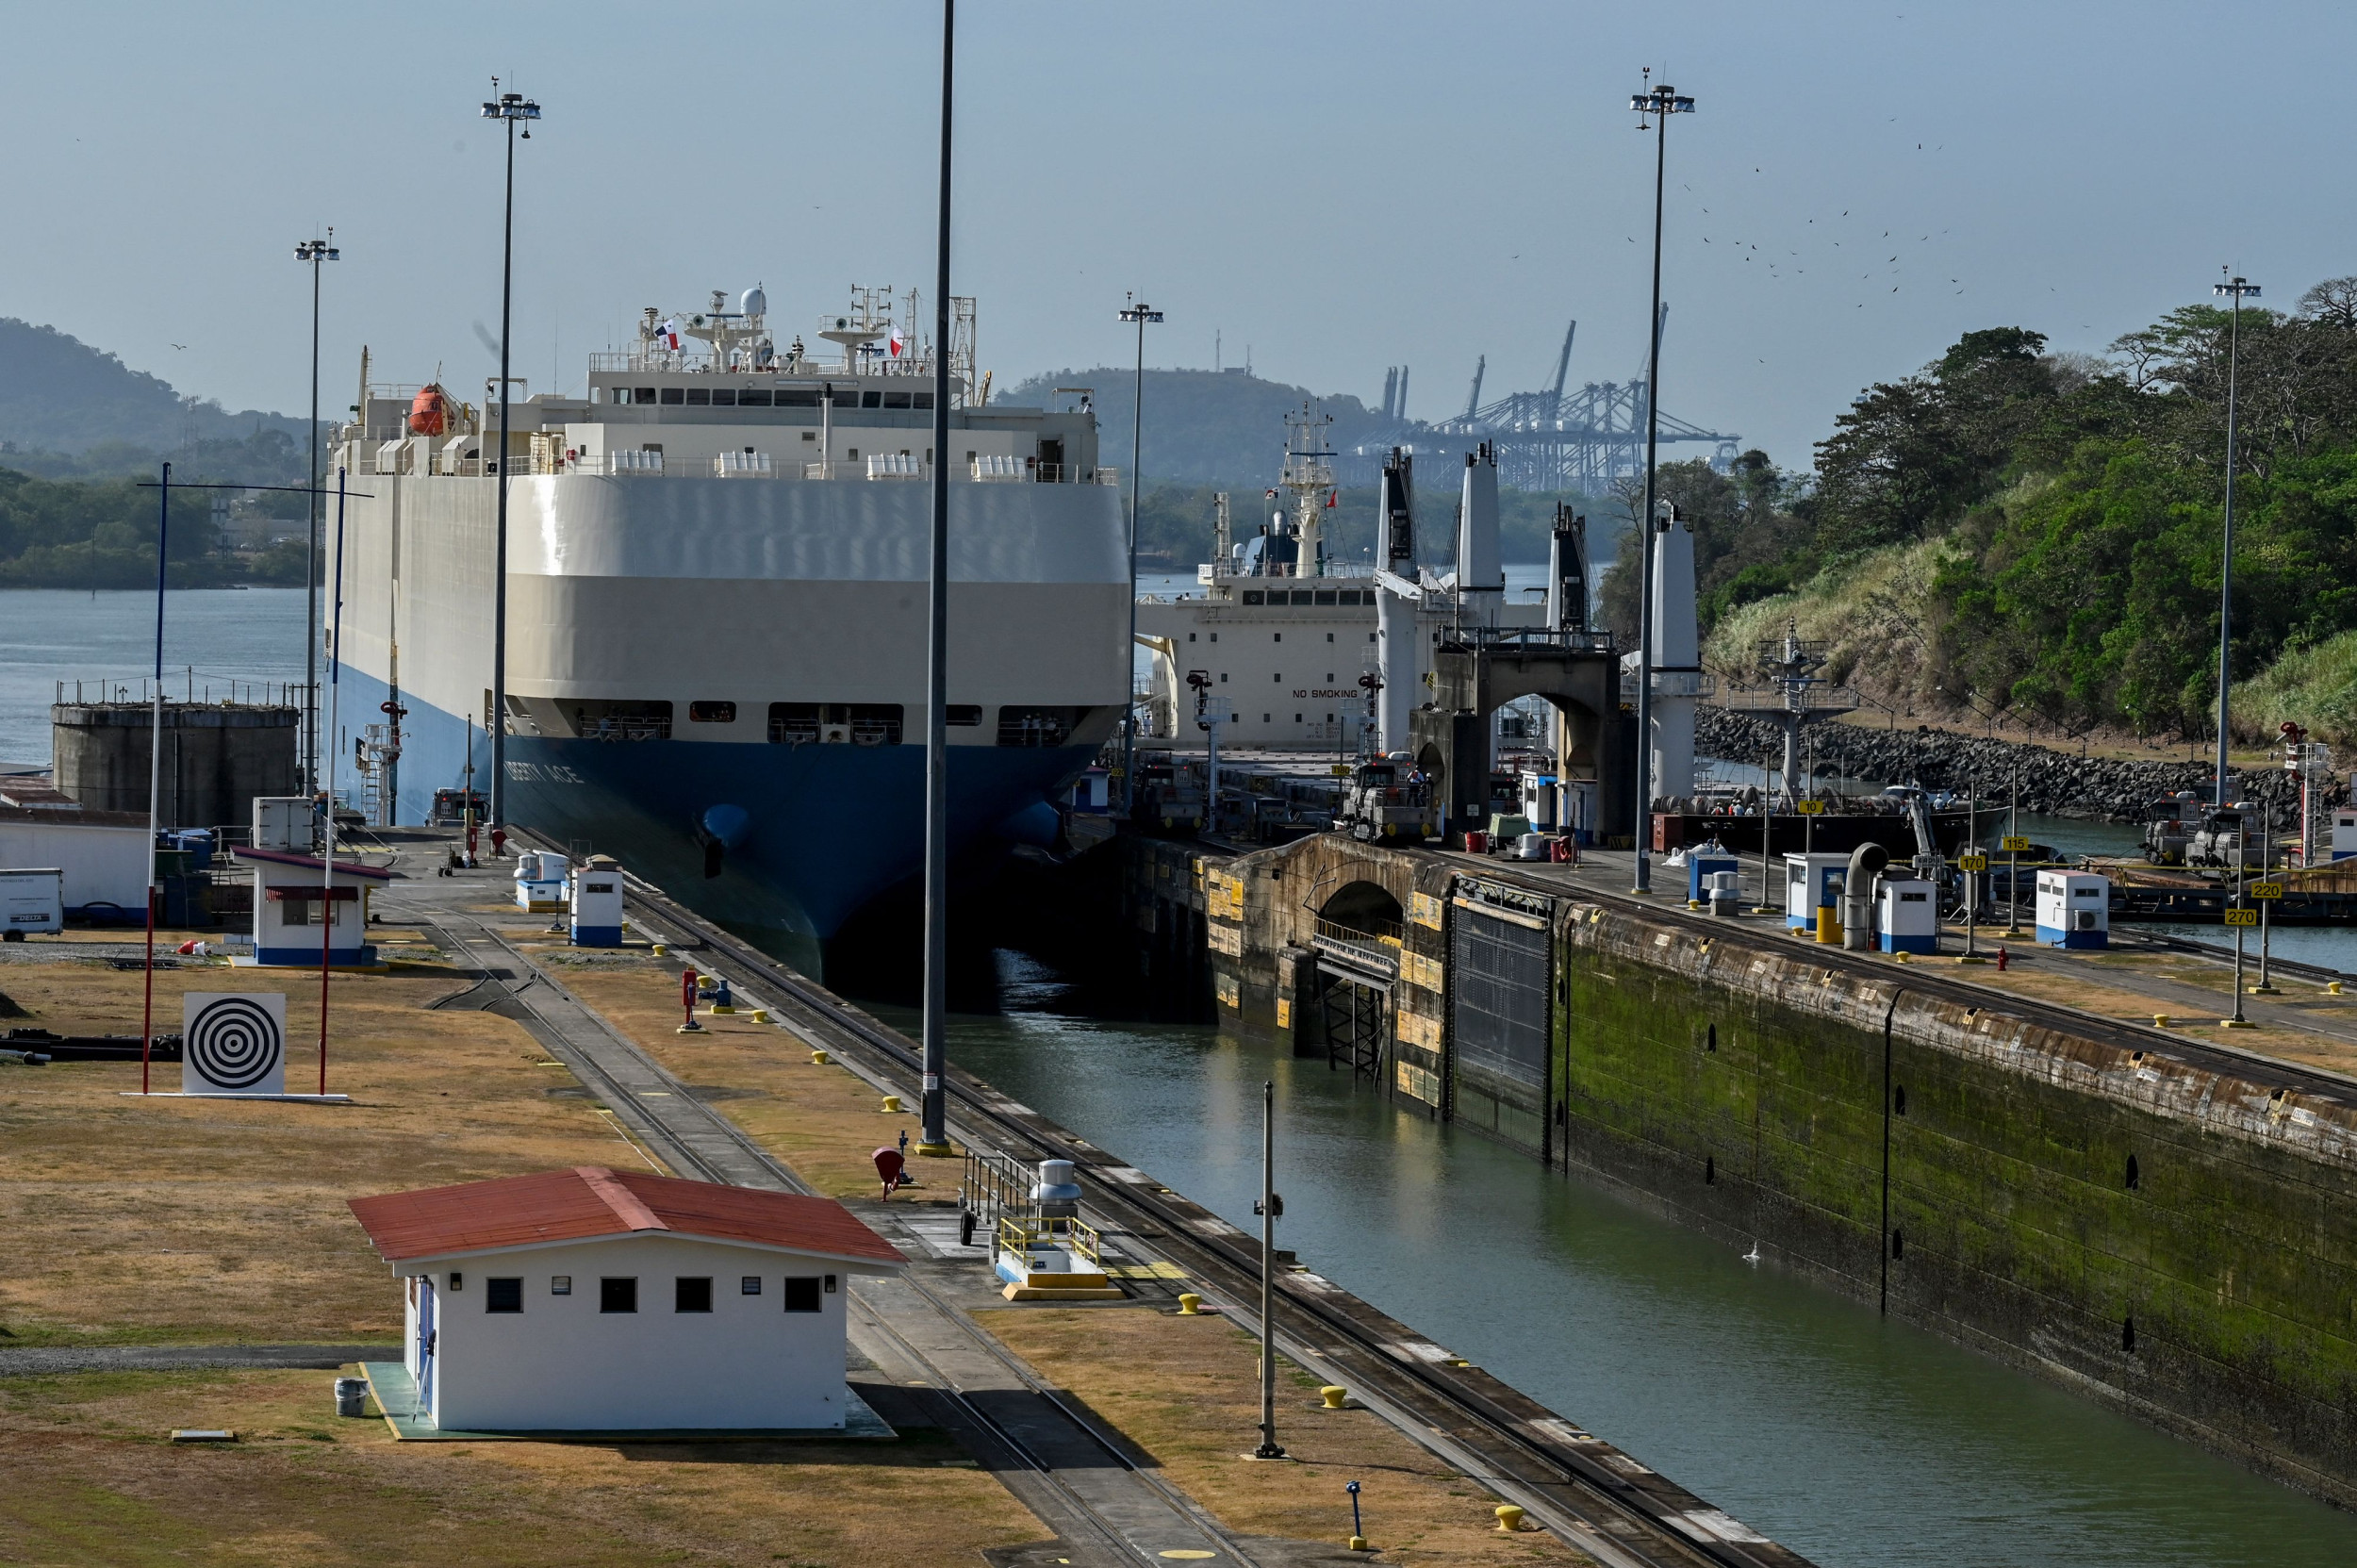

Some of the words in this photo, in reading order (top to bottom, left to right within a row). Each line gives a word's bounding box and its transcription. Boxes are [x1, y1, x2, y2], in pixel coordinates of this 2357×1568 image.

[1293, 689, 1307, 698] NO
[1311, 689, 1358, 698] SMOKING
[503, 760, 547, 782] LIBERTY
[544, 764, 585, 784] ACE
[1805, 801, 1817, 812] 10
[2006, 838, 2025, 850] 115
[1963, 857, 1983, 868] 170
[2254, 884, 2280, 897] 220
[2228, 911, 2254, 923] 270
